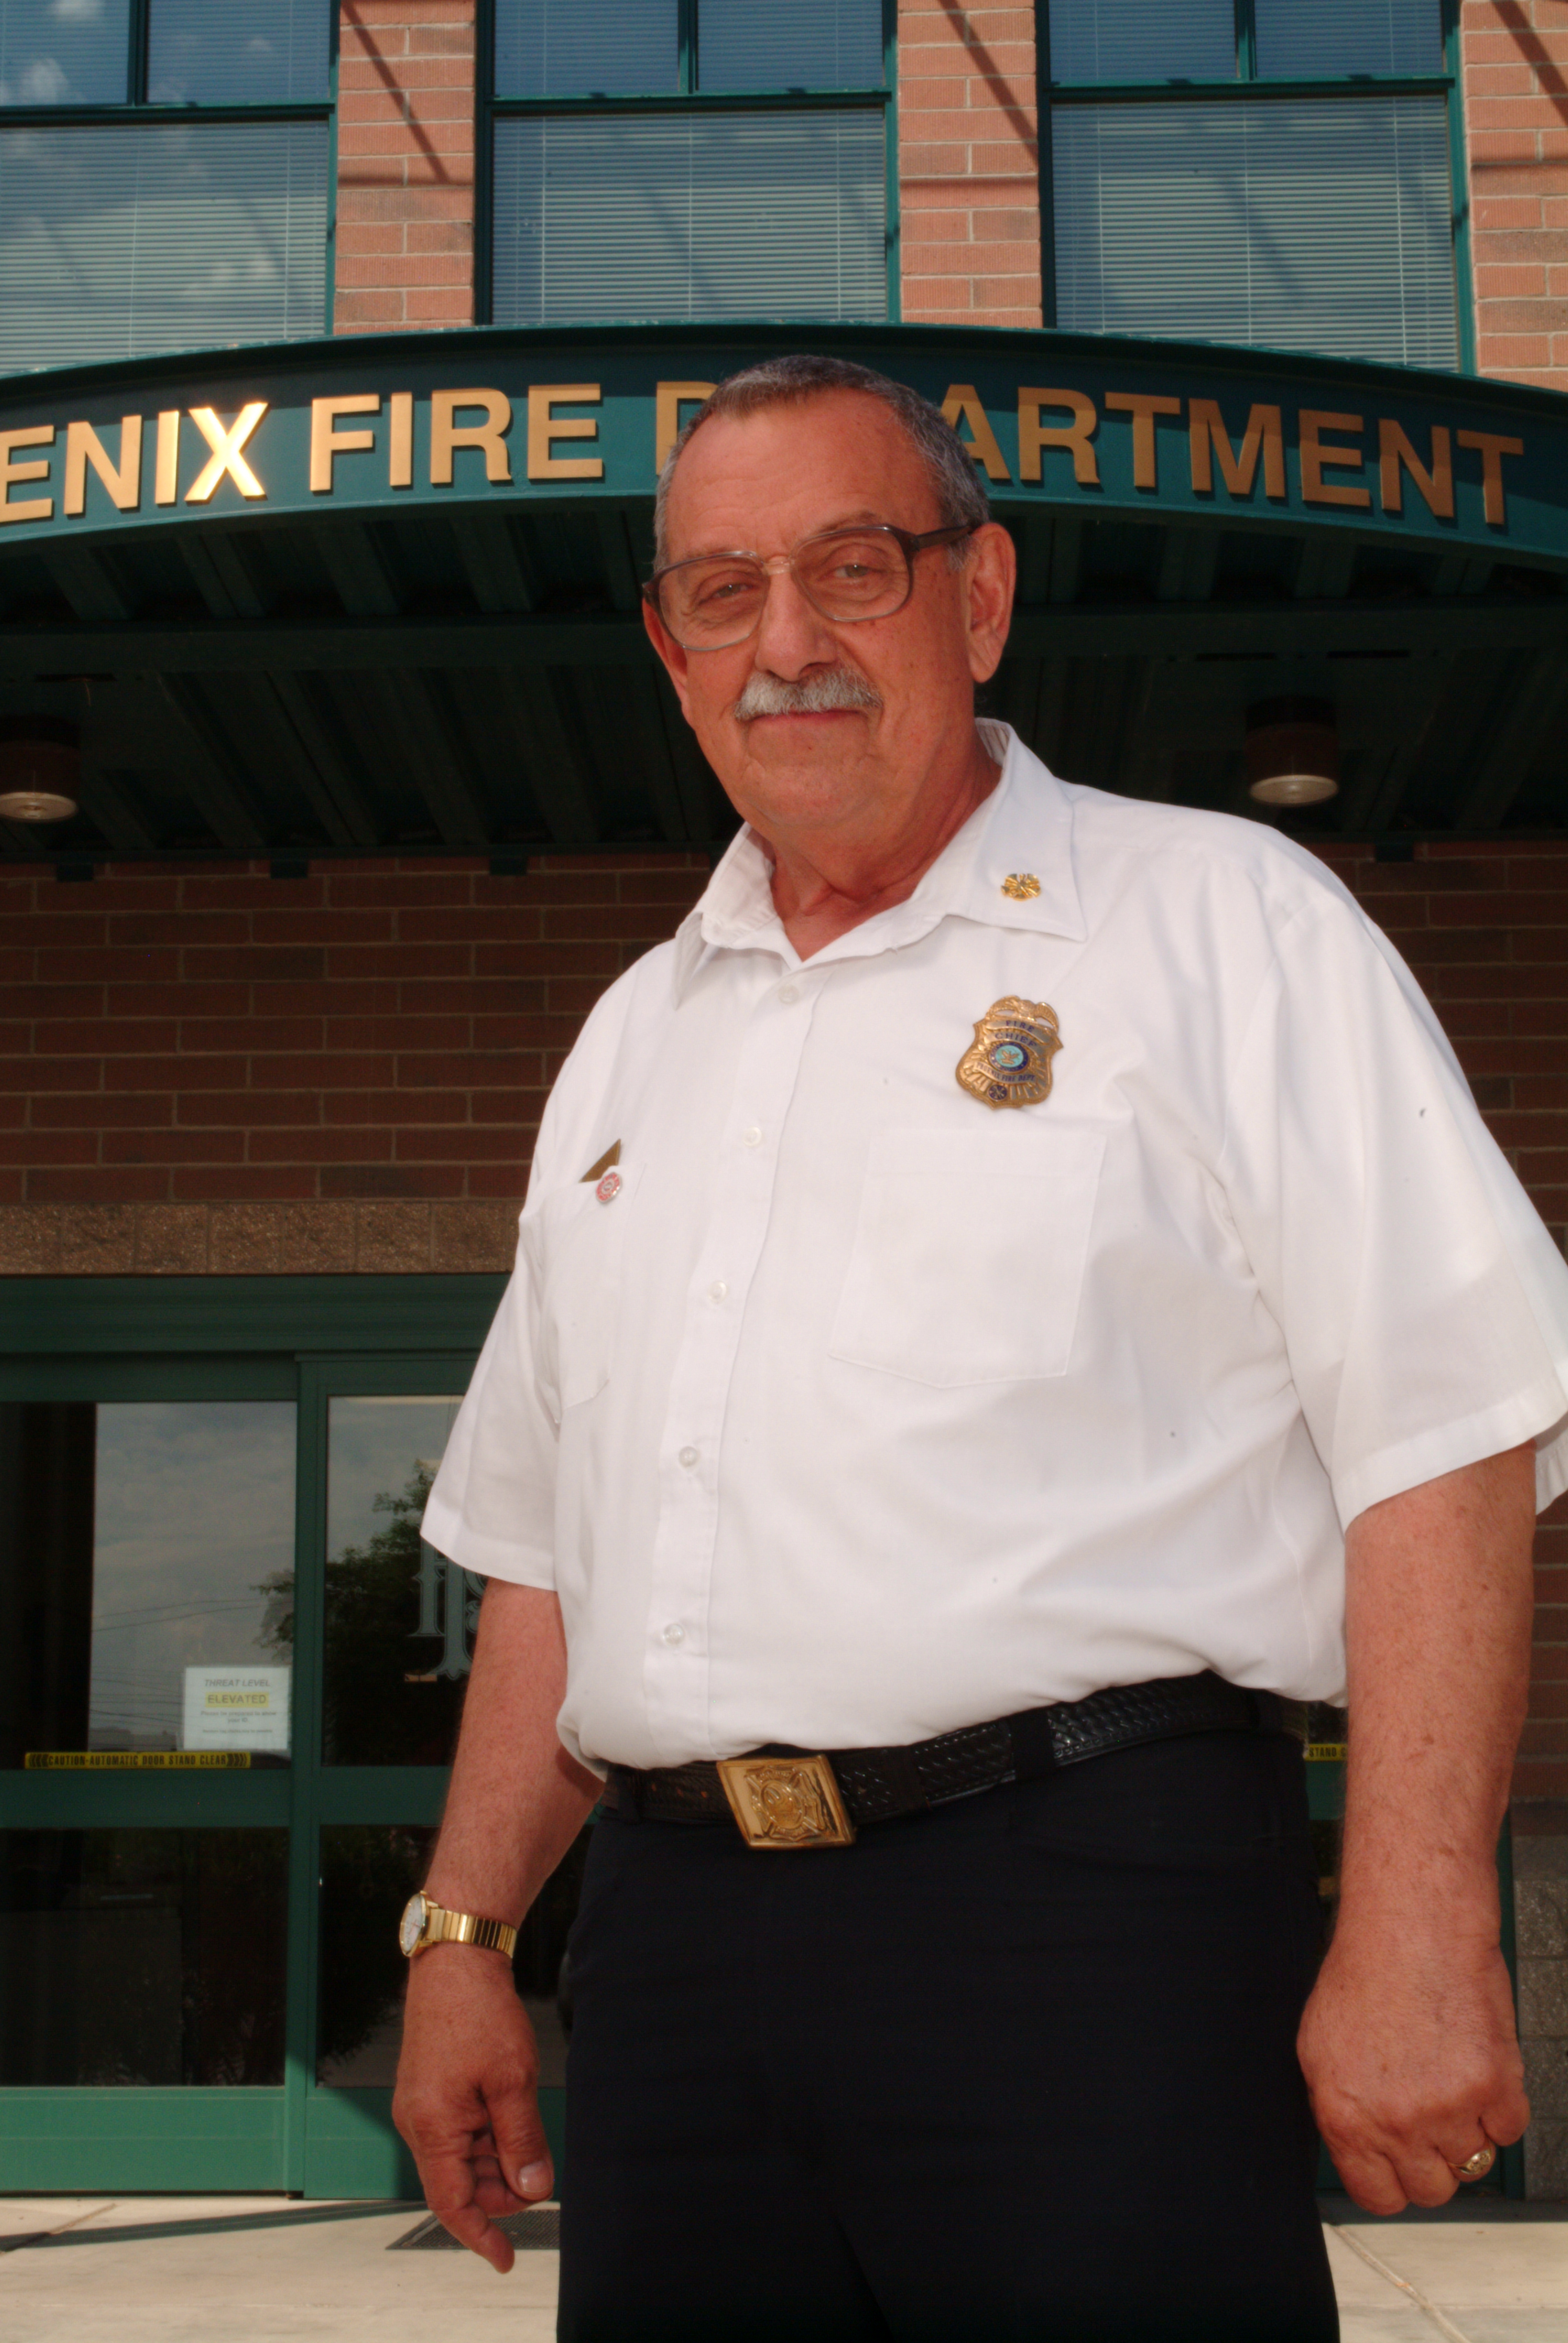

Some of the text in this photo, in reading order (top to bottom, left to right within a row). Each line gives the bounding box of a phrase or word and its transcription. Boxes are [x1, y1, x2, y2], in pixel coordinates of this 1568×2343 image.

[0, 381, 1524, 526] ENIX FIRE ARTMENT
[1005, 1020, 1035, 1033] FIRE
[995, 1032, 1037, 1048] CHIEF
[205, 1679, 270, 1687] THREAT LEVEL
[207, 1695, 266, 1704] ELEVATED
[1309, 1747, 1337, 1757] STAND
[142, 1755, 165, 1766] DOOR
[169, 1755, 196, 1766] STAND
[199, 1755, 226, 1766] CLEAR
